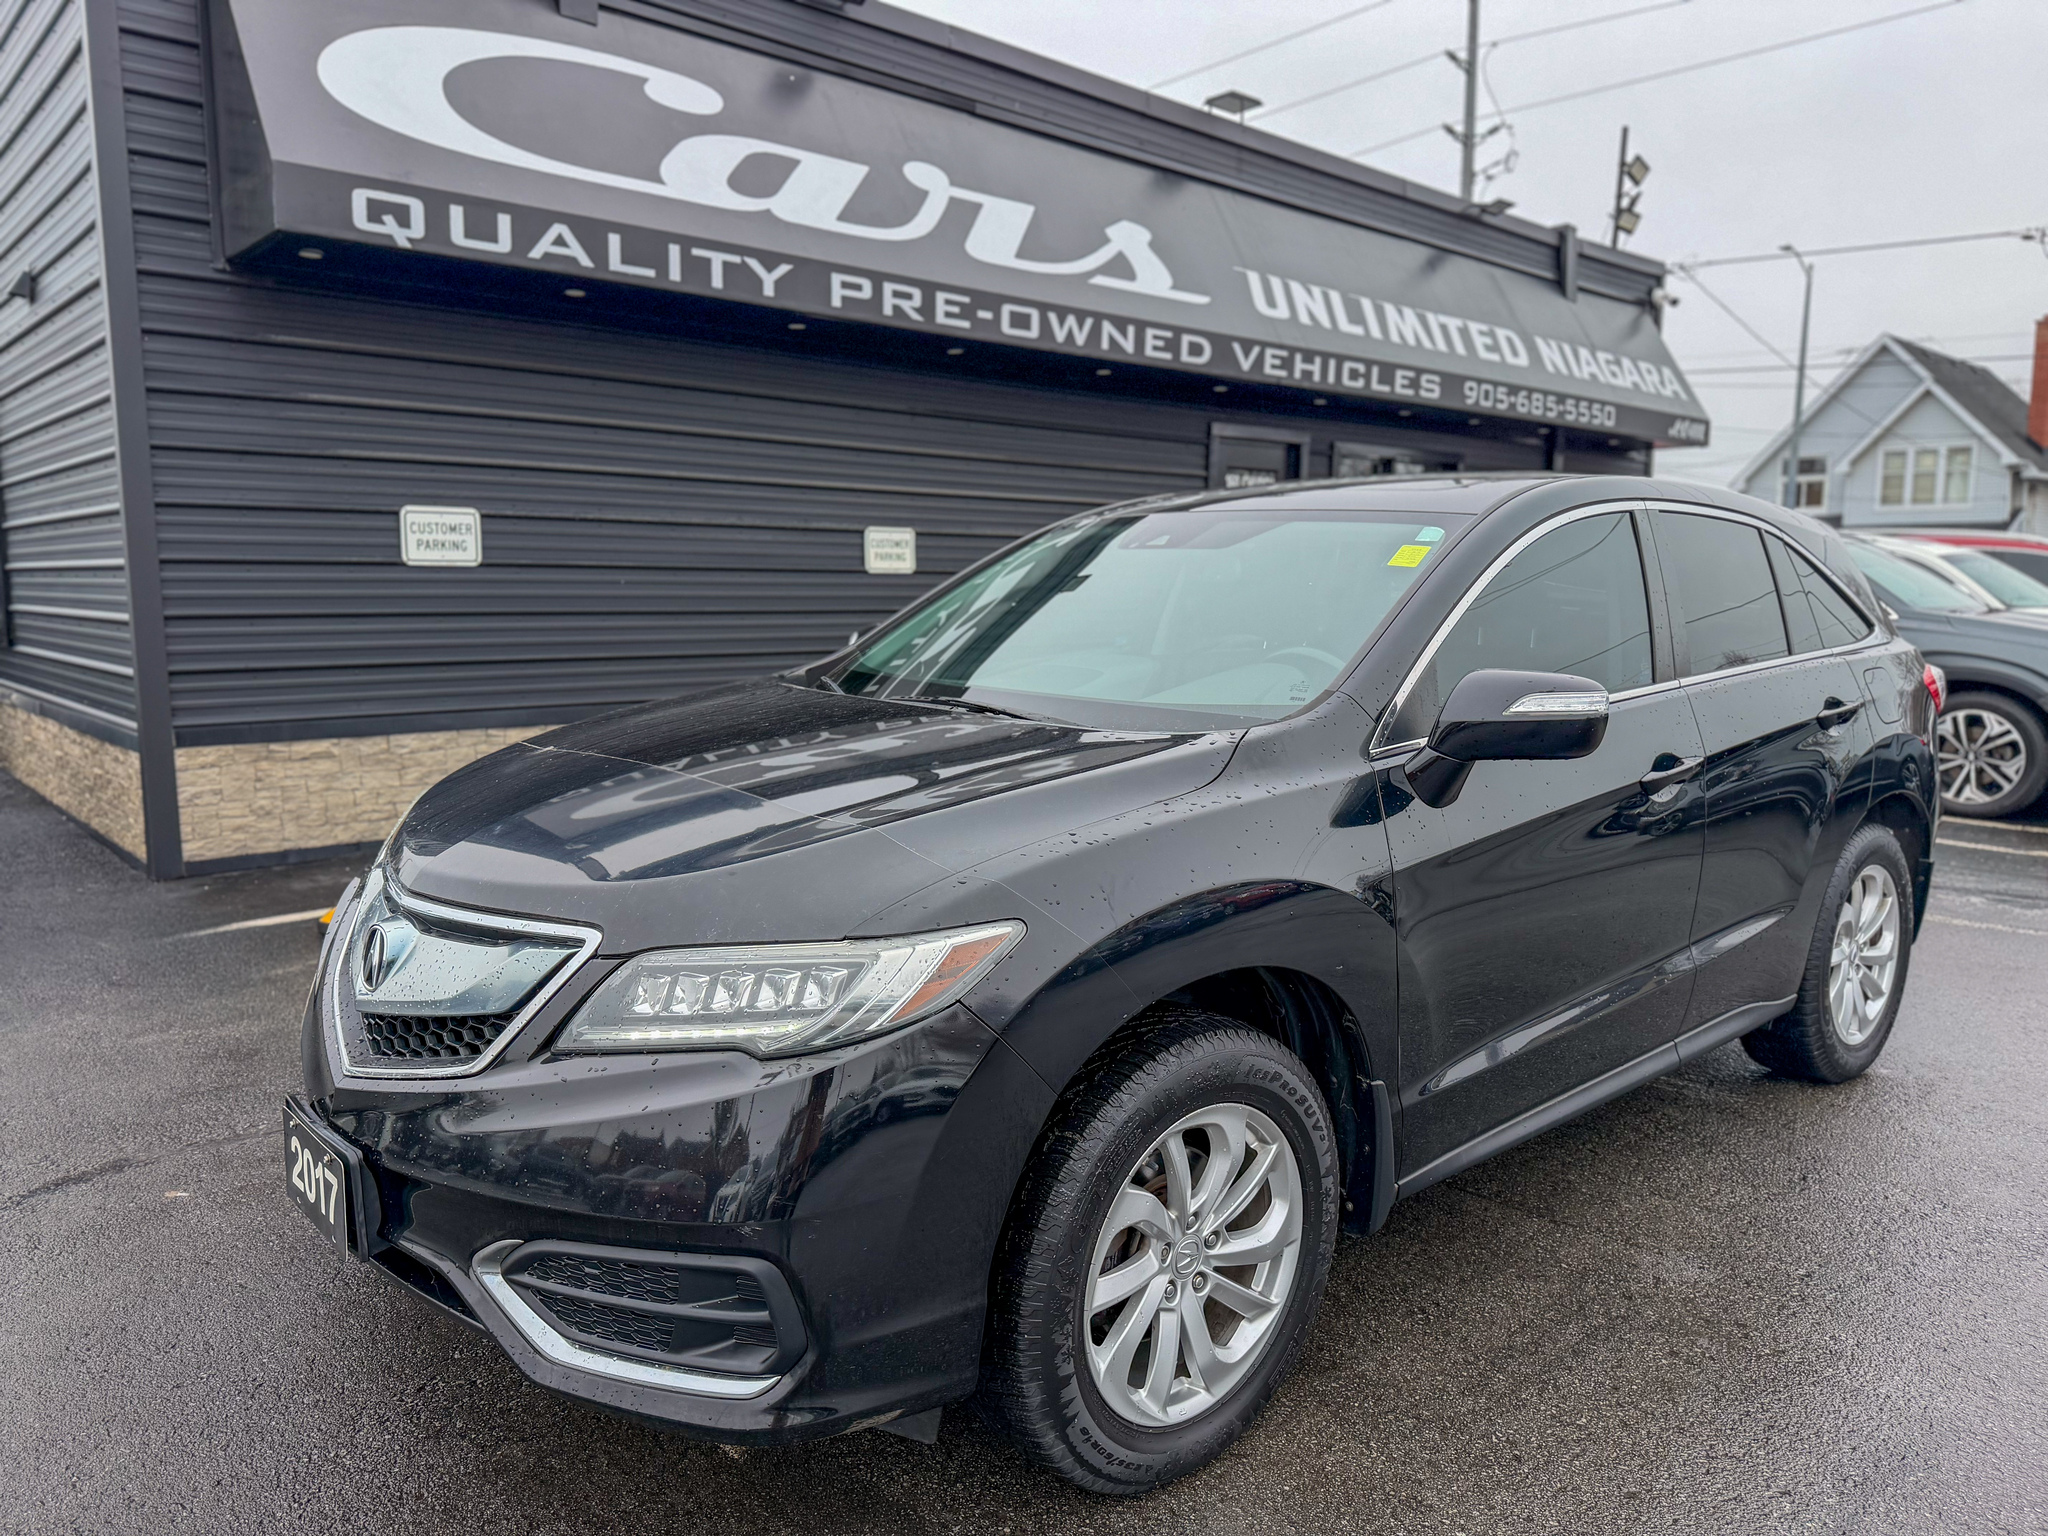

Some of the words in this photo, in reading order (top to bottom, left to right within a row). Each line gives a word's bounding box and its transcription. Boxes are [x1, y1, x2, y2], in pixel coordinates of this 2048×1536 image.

[317, 26, 1211, 305] Cars
[351, 188, 793, 297] QUALITY
[830, 271, 1213, 365] PRE-OWNED
[1231, 341, 1441, 401] VEHICLES
[1233, 266, 1530, 367] UNLIMITED
[1532, 335, 1688, 400] NIAGARA
[409, 521, 473, 536] CUSTOMER
[416, 538, 468, 552] PARKING
[871, 538, 909, 549] CUSTOMER
[874, 551, 906, 562] PARKING
[291, 1135, 338, 1225] 2017
